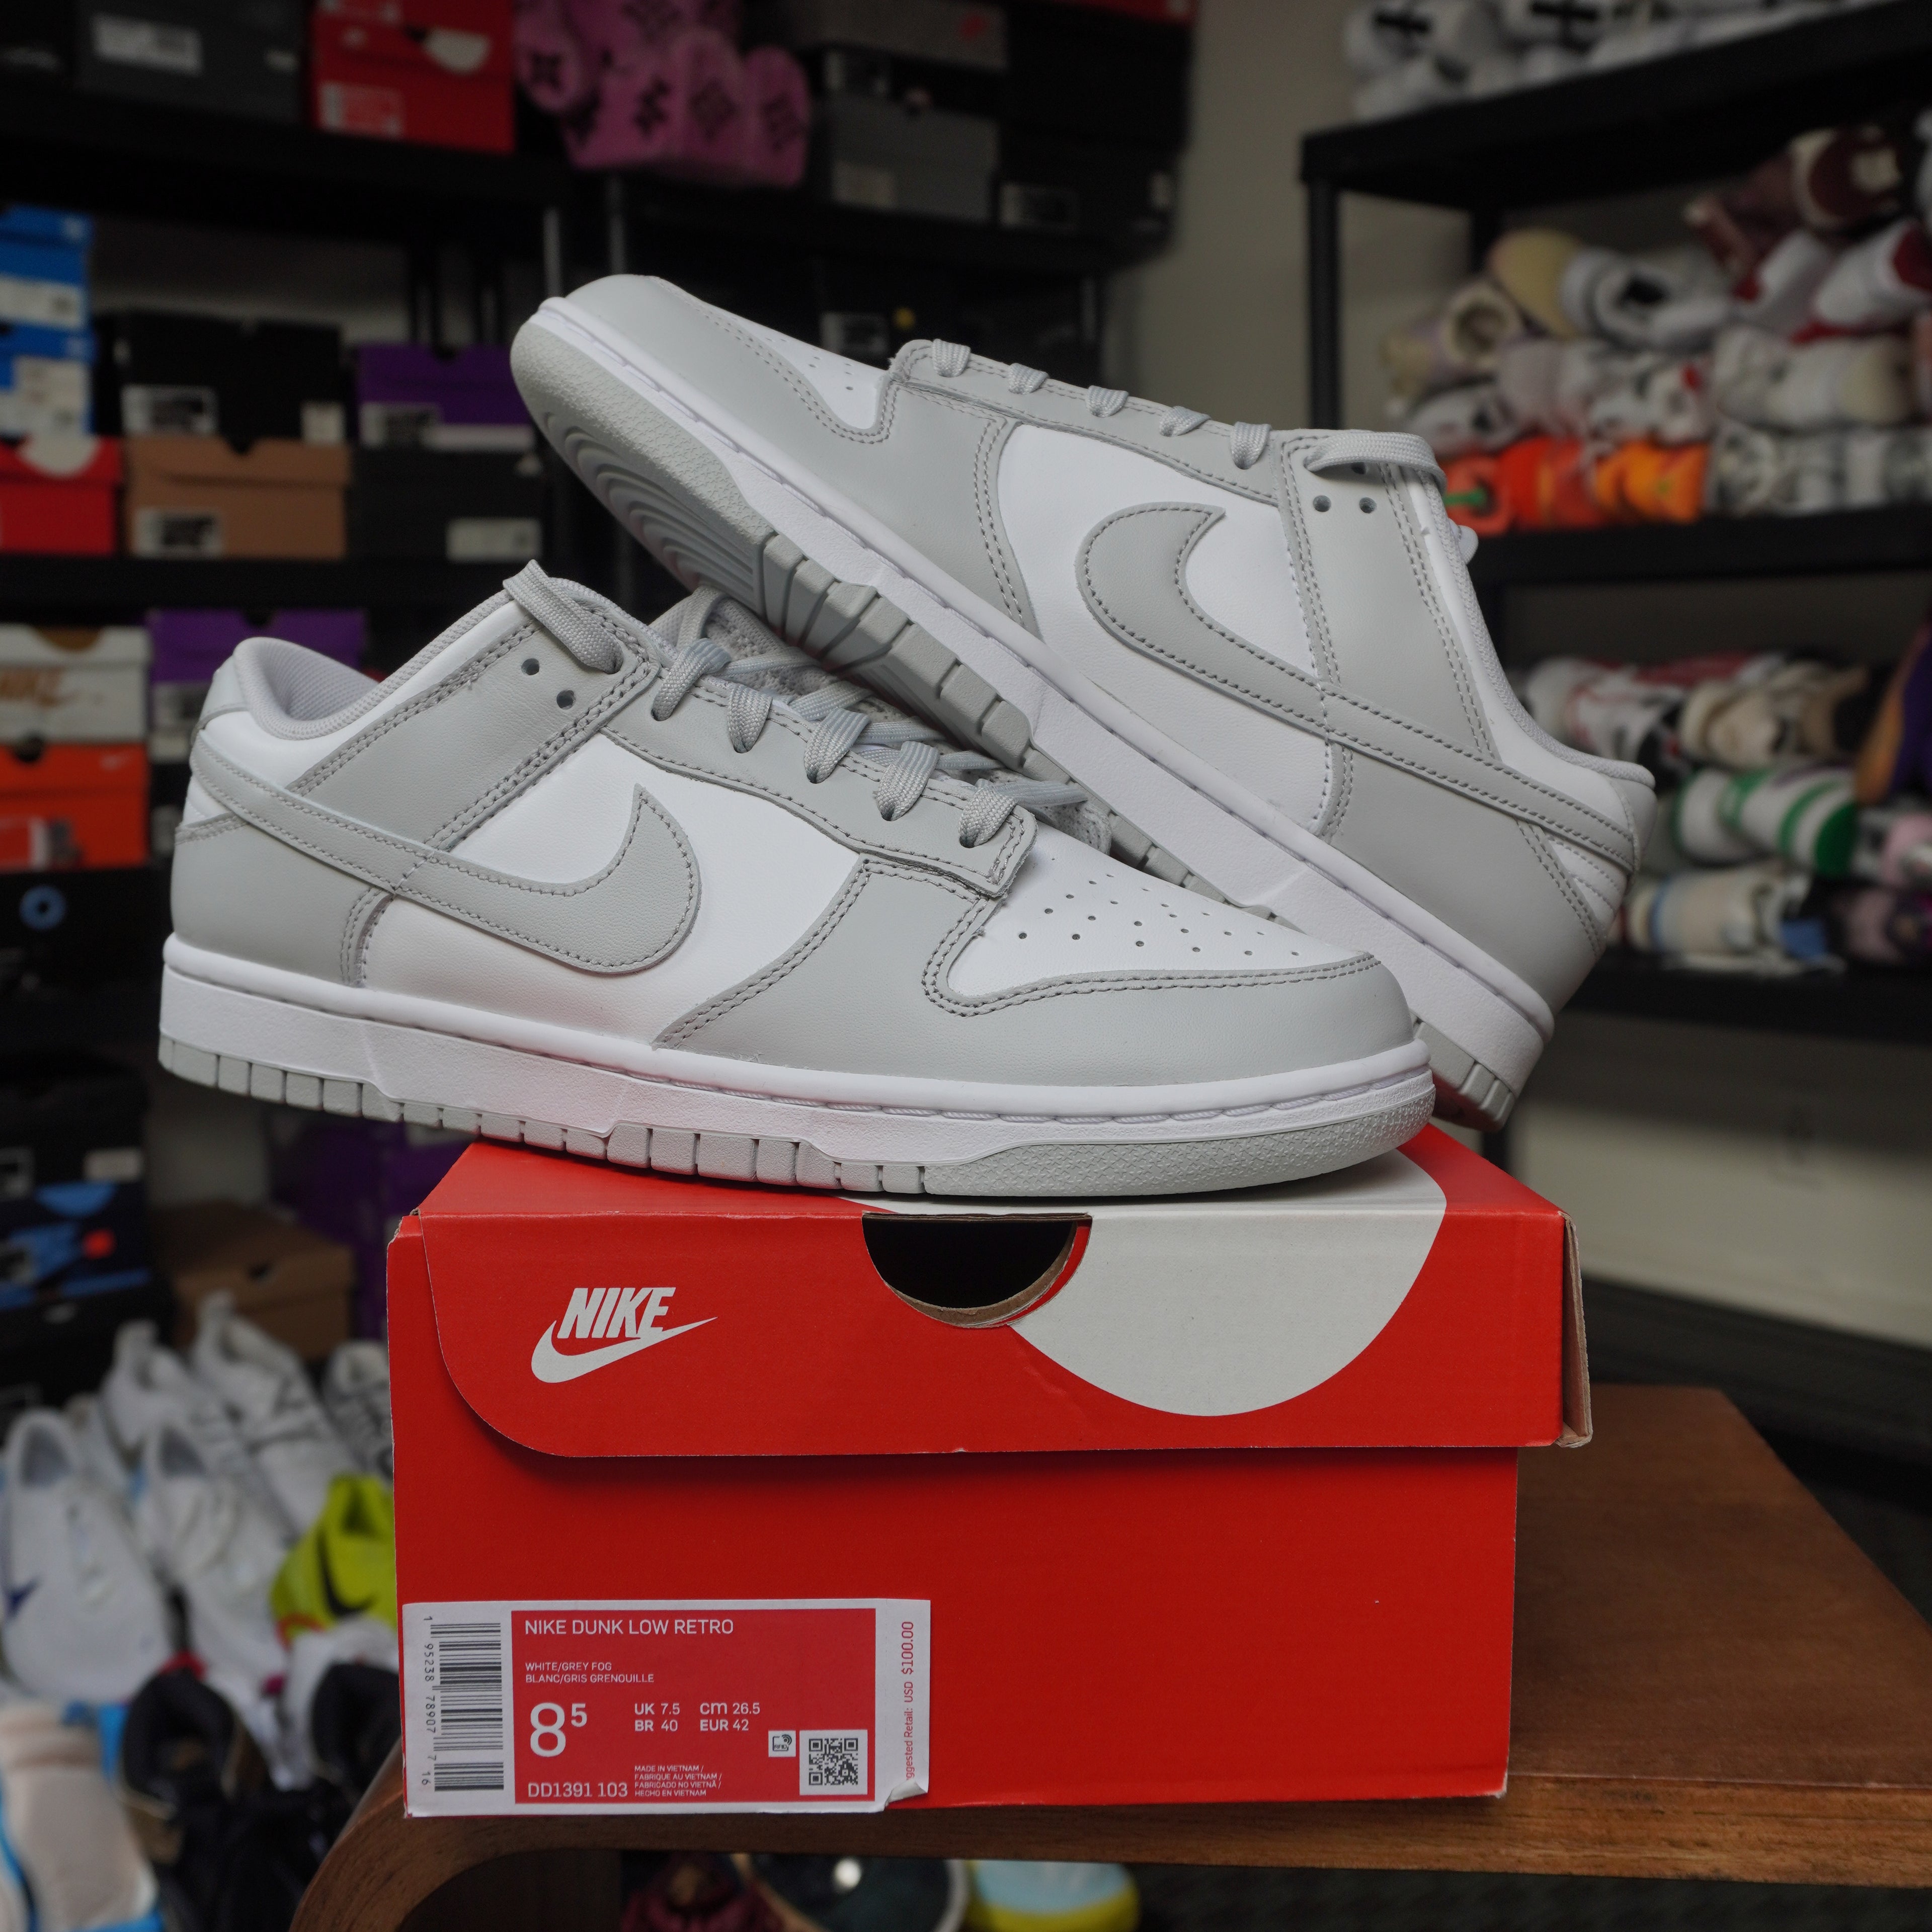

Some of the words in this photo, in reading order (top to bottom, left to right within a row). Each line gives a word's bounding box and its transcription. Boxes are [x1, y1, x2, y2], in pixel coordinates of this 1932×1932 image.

[557, 1287, 676, 1339] NIKE
[525, 1620, 567, 1635] NIKE
[572, 1620, 623, 1635] DUNK
[629, 1619, 669, 1635] LOW
[674, 1619, 734, 1634] RETRO
[901, 1622, 914, 1675] $100.00
[424, 1643, 434, 1681] 95238
[525, 1662, 589, 1672] WHITE/GREY
[592, 1662, 612, 1671] FOG
[526, 1674, 587, 1684] BLANC/GRIS
[590, 1674, 654, 1683] GRENOUILLE
[904, 1681, 913, 1703] USD
[426, 1696, 436, 1733] 78907
[634, 1703, 655, 1715] UK
[661, 1703, 680, 1715] 7.5
[700, 1703, 728, 1715] cm
[733, 1702, 760, 1715] 26.5
[634, 1720, 654, 1731] BR
[661, 1719, 678, 1732] 40
[700, 1719, 729, 1731] EUR
[733, 1719, 749, 1731] 42
[904, 1708, 913, 1738] Retail:
[904, 1741, 915, 1781] ggested
[634, 1774, 671, 1782] FABRIQUE
[690, 1780, 716, 1788] VIETNÃ
[528, 1782, 592, 1798] DD1391
[598, 1782, 628, 1797] 103
